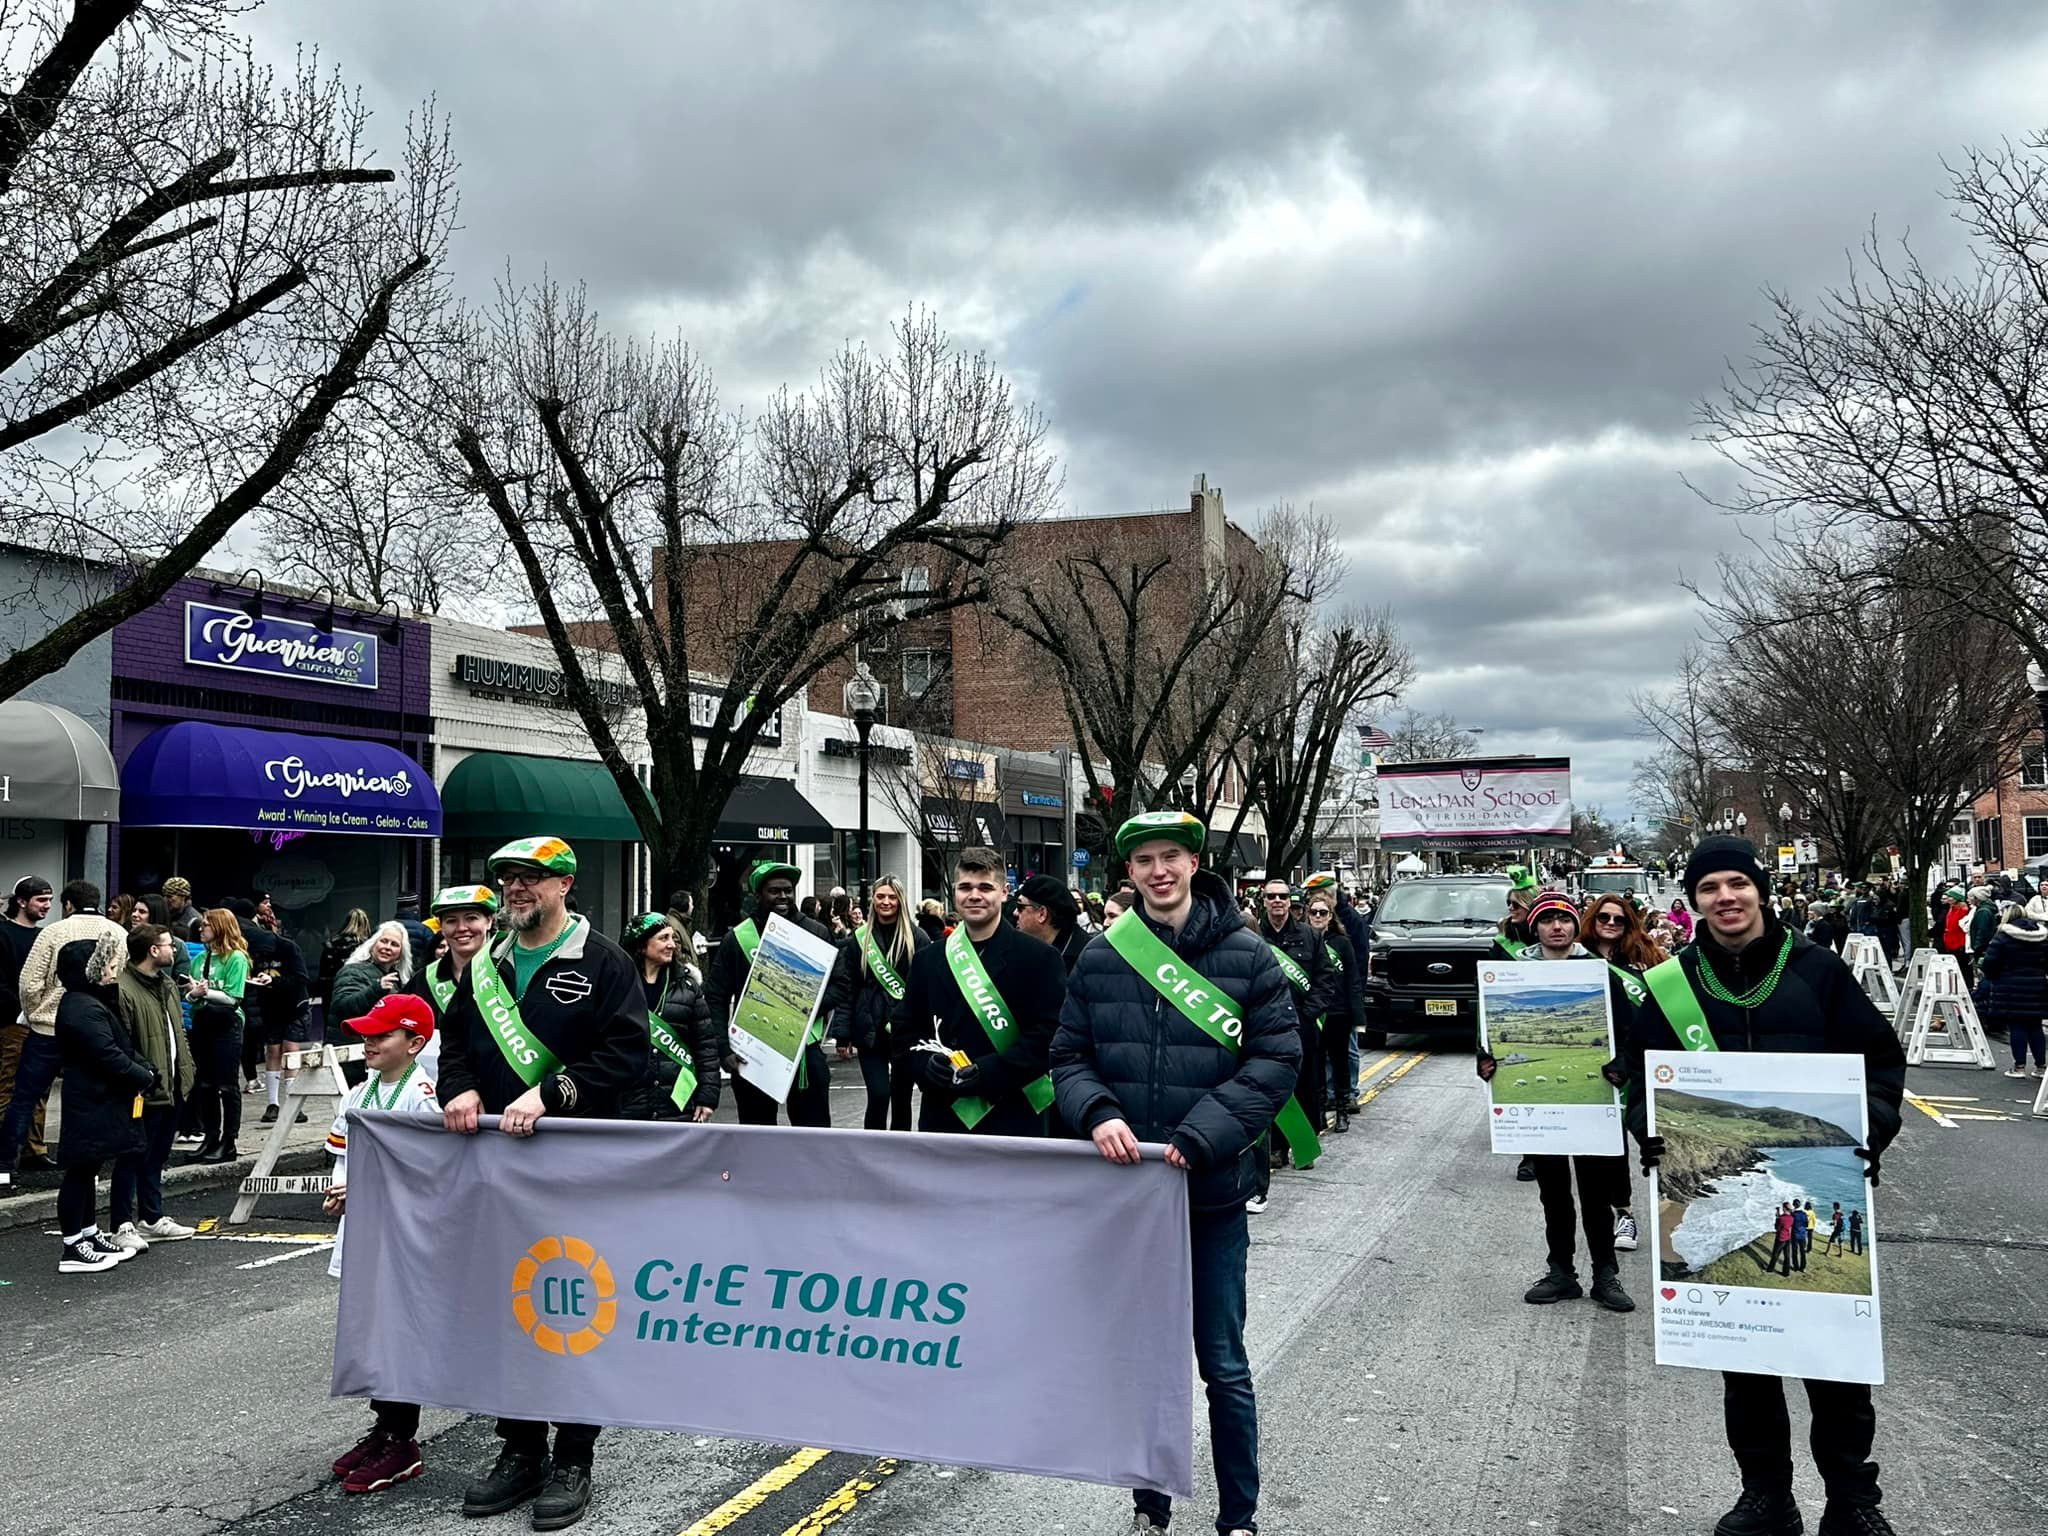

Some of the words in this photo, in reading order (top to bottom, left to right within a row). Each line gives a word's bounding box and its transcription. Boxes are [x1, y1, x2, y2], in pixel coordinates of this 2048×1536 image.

[463, 655, 561, 696] HUMMUS
[265, 755, 412, 798] Guerriero
[257, 808, 286, 821] Award
[294, 809, 327, 827] Winning
[329, 812, 340, 824] Ice
[342, 812, 368, 825] Cream
[376, 815, 400, 828] Gelato
[407, 816, 428, 829] Cakes
[758, 827, 773, 839] CLEAN
[1415, 812, 1431, 822] OF
[1437, 812, 1476, 821] IRISH
[1482, 810, 1529, 820] DANCE
[873, 957, 905, 996] TOURS
[1281, 959, 1311, 991] TOURS
[961, 966, 1009, 1031] TOURS
[485, 994, 540, 1066] TOURS
[651, 1025, 693, 1065] TOURS
[286, 1179, 296, 1190] OF
[543, 1275, 587, 1317] CIE
[763, 1268, 968, 1327] TOURS
[1687, 1309, 1711, 1317] views
[635, 1310, 964, 1369] International
[1706, 1334, 1747, 1343] comments
